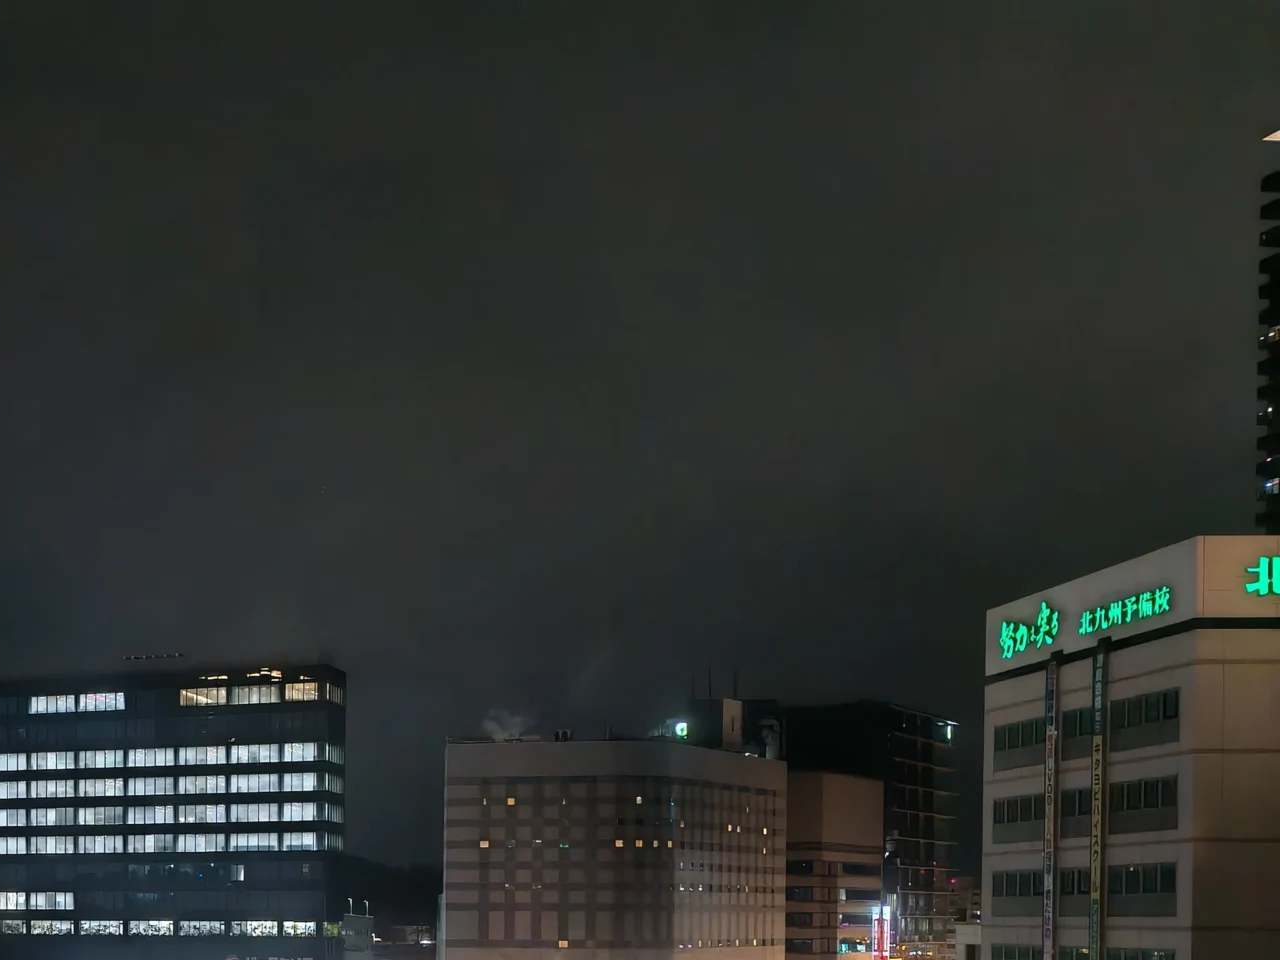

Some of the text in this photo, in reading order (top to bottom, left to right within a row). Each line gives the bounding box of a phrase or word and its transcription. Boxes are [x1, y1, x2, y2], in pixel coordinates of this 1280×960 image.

[999, 601, 1060, 659] 努力は実る
[1078, 586, 1171, 636] 北九州予備校
